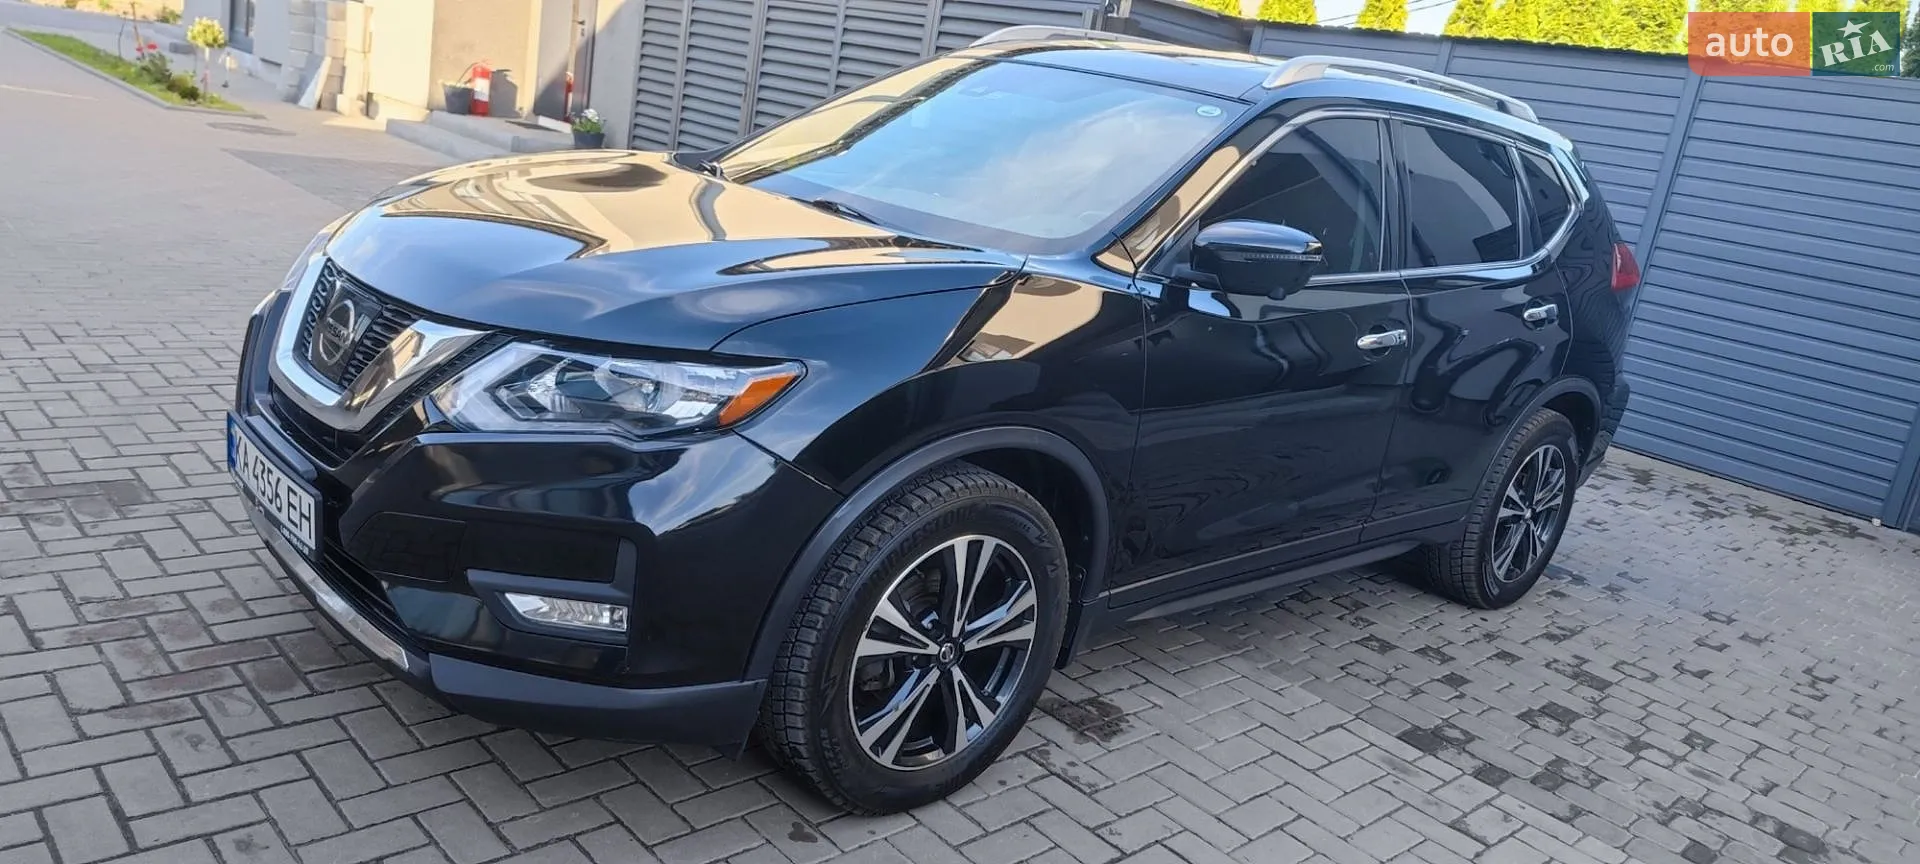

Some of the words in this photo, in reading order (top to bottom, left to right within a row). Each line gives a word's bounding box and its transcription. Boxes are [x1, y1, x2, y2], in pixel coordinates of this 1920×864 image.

[235, 430, 251, 481] KA
[252, 454, 283, 513] 4356
[287, 484, 312, 540] EH
